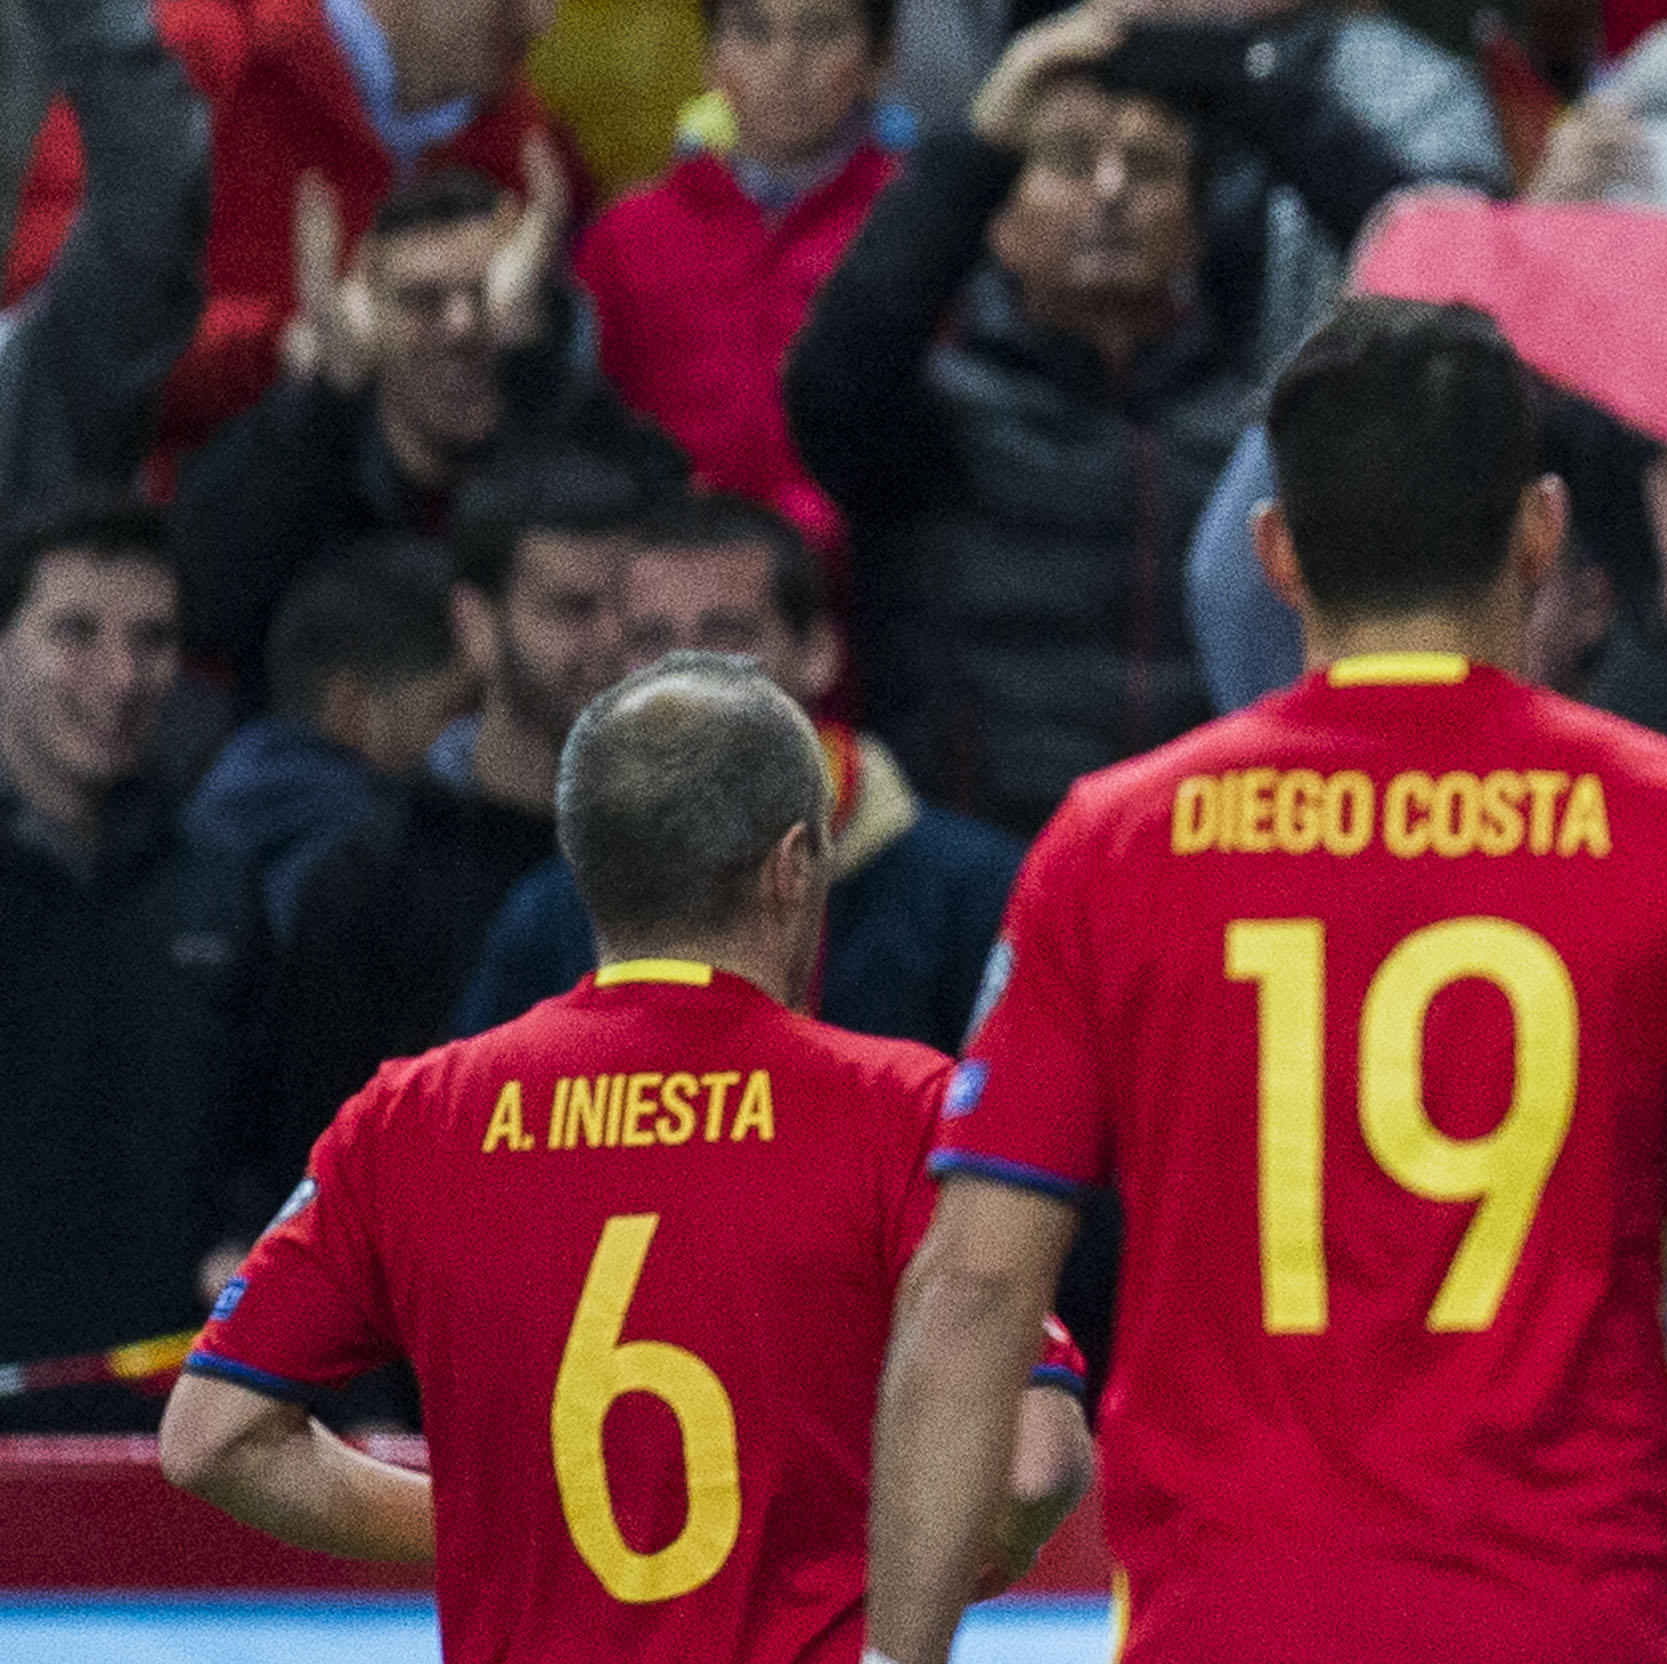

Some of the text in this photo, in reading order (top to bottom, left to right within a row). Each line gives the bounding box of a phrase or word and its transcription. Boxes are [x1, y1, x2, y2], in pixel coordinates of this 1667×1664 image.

[1171, 768, 1611, 858] DIEGO COSTA
[482, 1069, 776, 1153] A. INIESTA
[1224, 915, 1580, 1335] 19
[550, 1213, 742, 1605] 6
